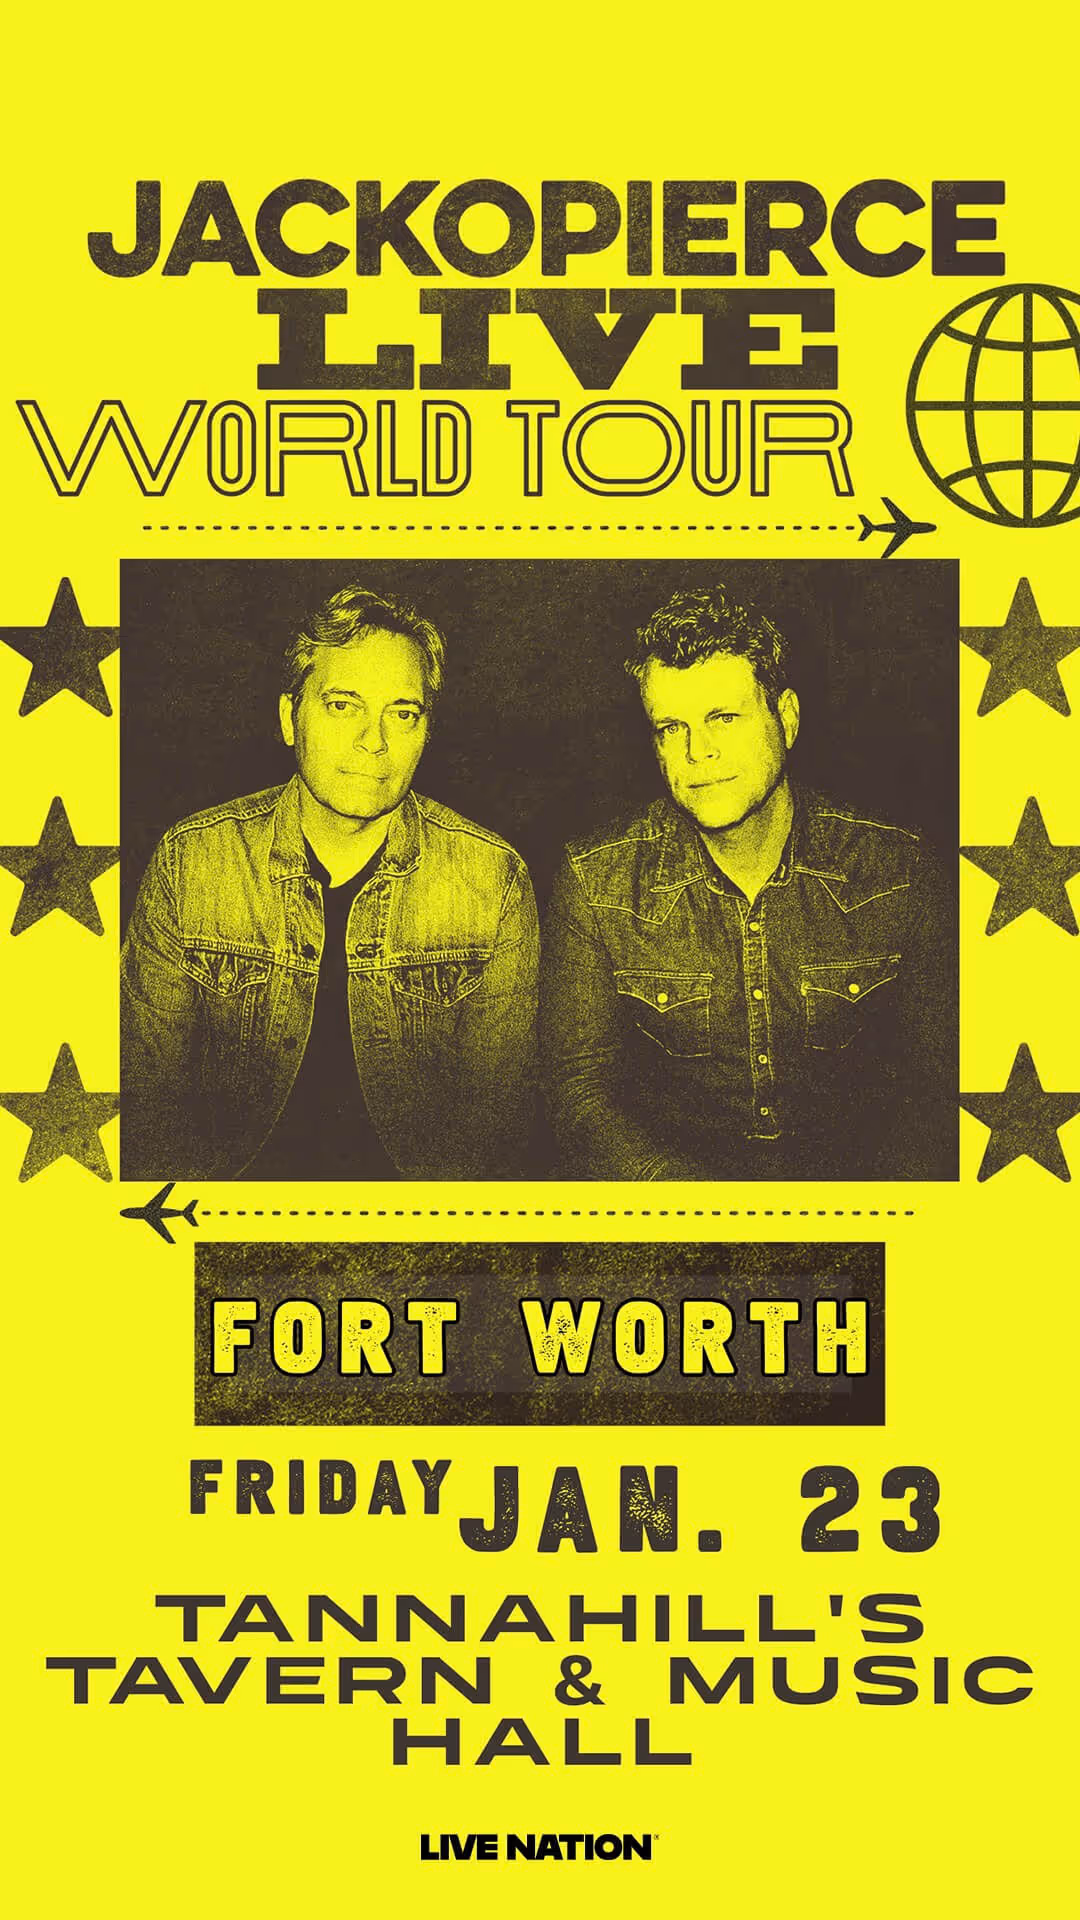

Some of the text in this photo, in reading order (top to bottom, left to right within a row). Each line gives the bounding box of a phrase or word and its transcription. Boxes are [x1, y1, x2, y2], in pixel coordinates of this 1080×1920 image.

[87, 178, 1006, 279] JACKOPIERCE
[256, 287, 839, 391] LIVE
[15, 399, 855, 497] WORLD TOUR
[211, 1298, 871, 1375] FORT WORTH
[189, 1459, 941, 1554] FRIDAY JAN. 23
[155, 1592, 924, 1644] TANNAHILL'S
[46, 1654, 1034, 1706] TAVERN & MUSIC
[392, 1717, 692, 1766] HALL
[420, 1833, 652, 1861] LIVE NATION
